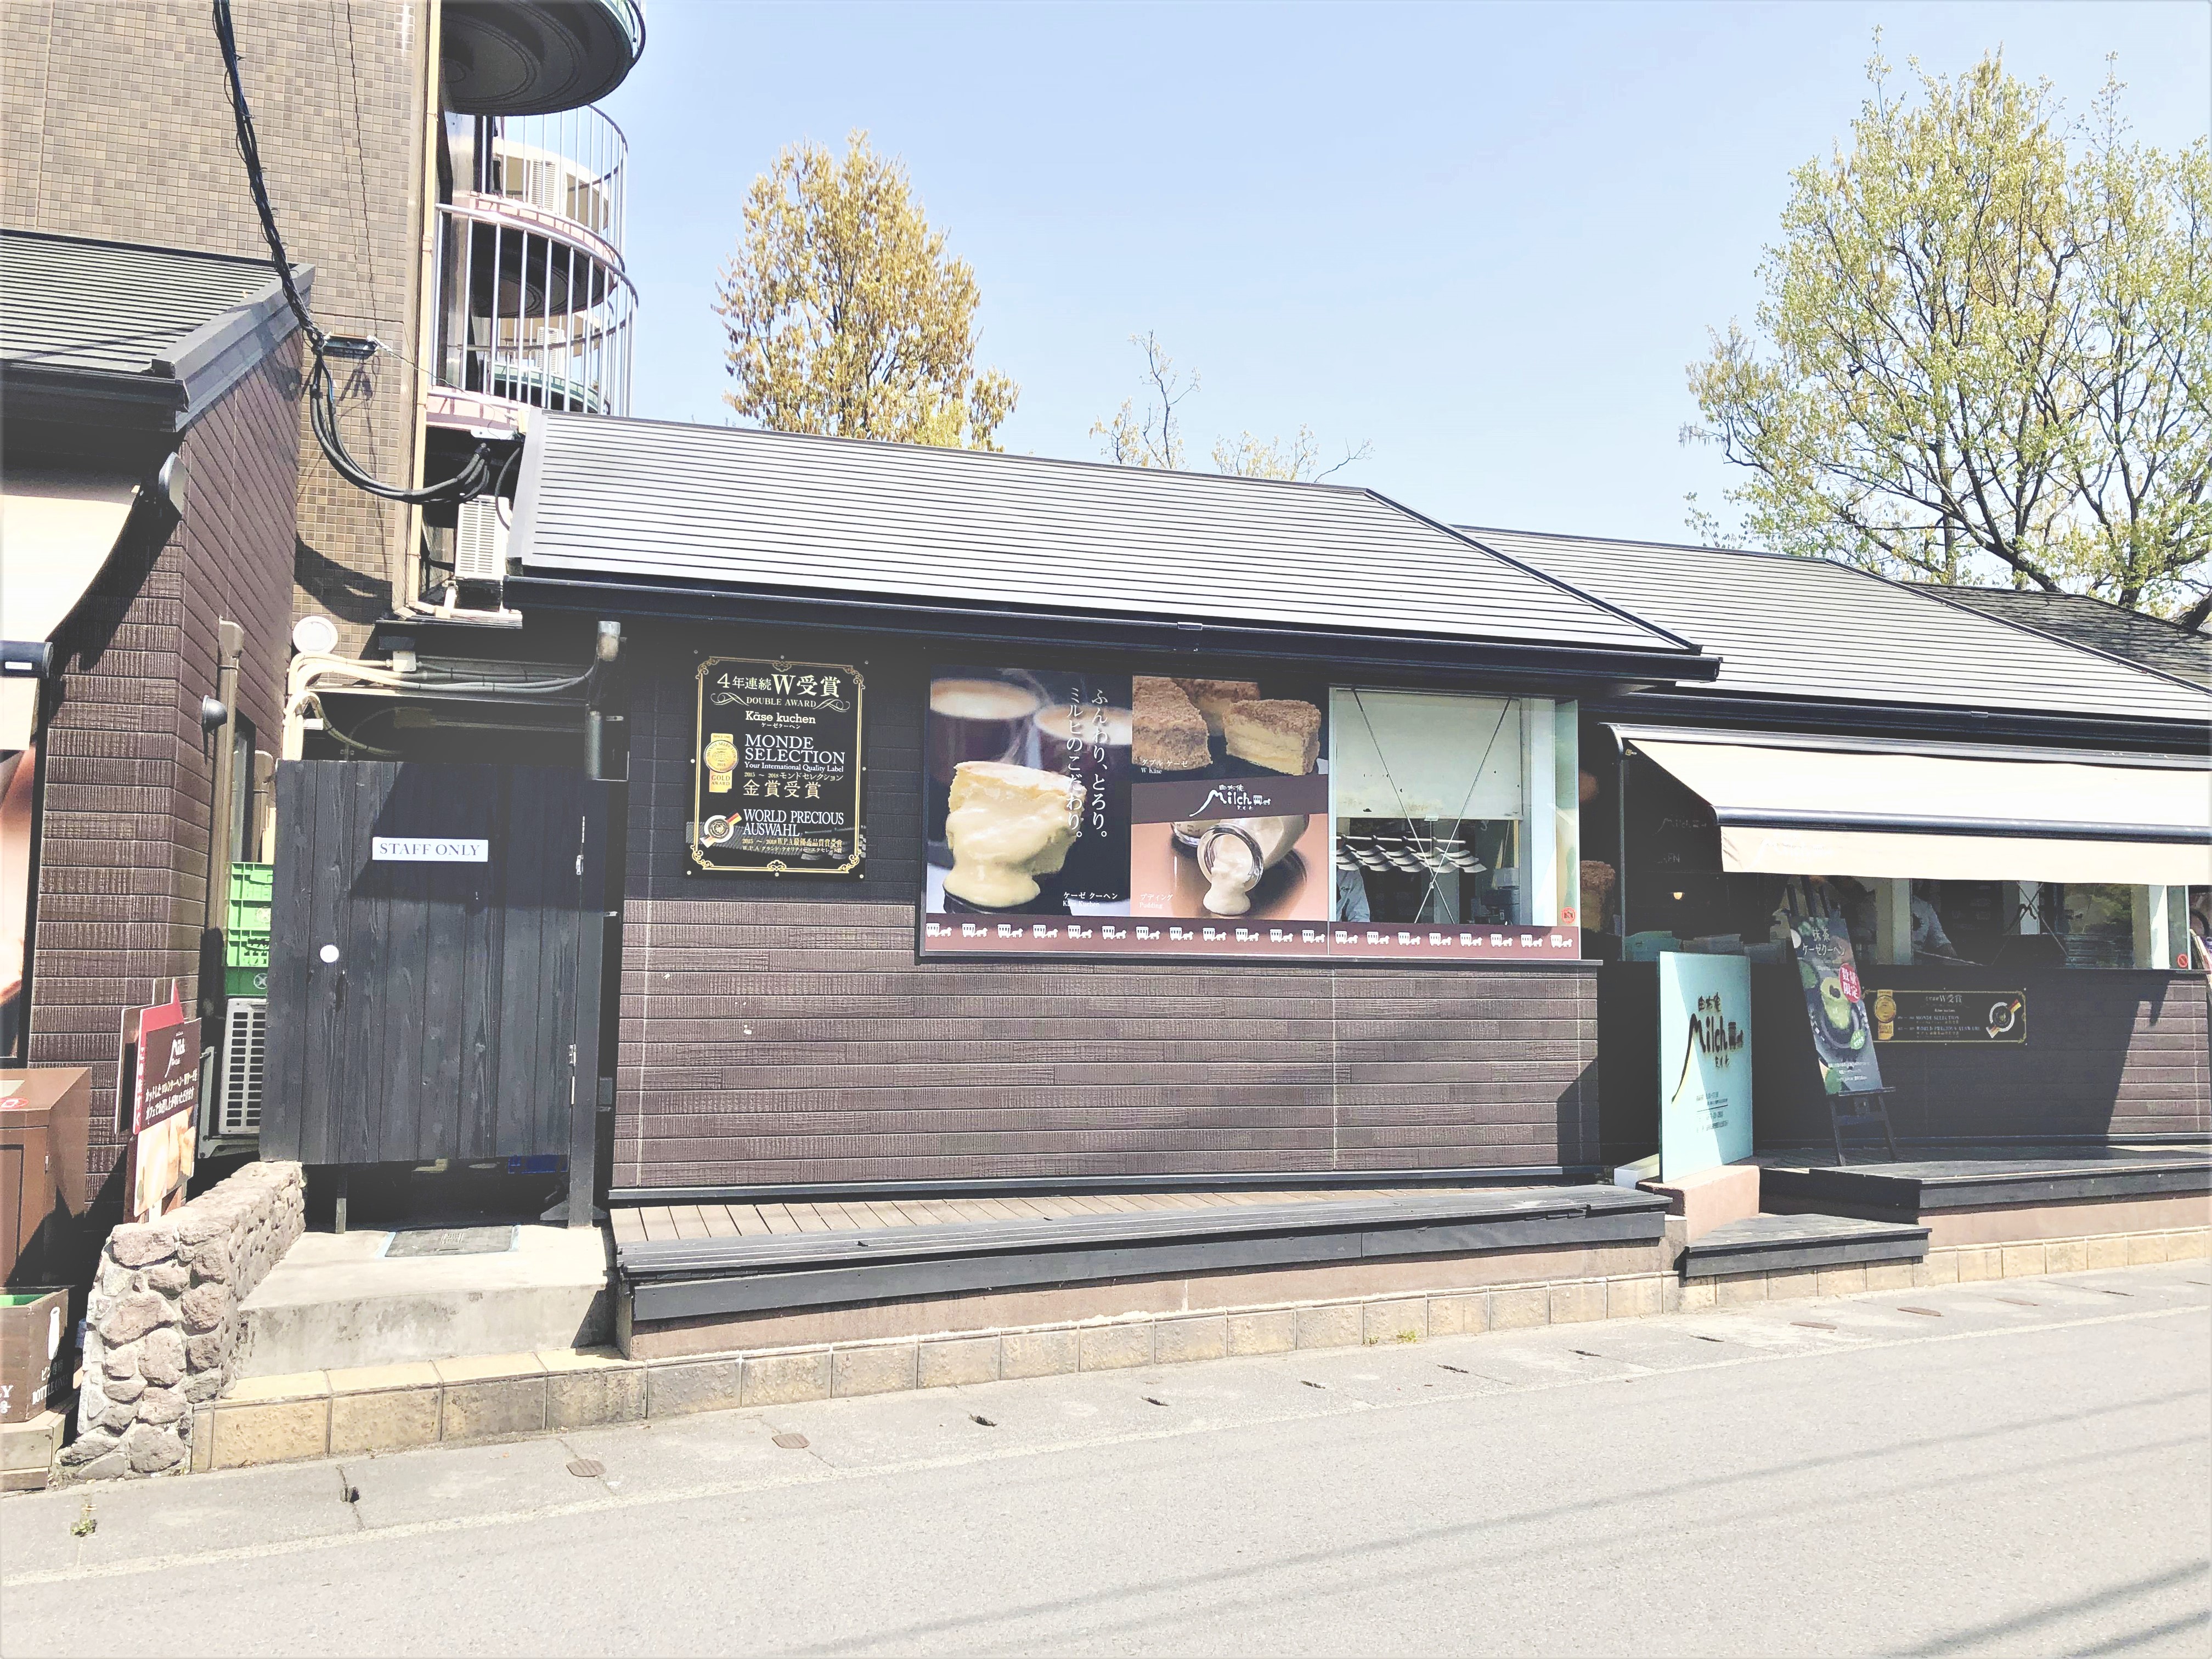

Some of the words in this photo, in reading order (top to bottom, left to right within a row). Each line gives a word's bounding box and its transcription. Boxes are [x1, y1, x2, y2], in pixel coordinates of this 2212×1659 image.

[717, 673, 840, 698] 4年連続W受賞
[746, 697, 782, 706] DOUBLE
[785, 698, 816, 708] AWARD
[745, 710, 774, 722] Käse
[776, 712, 816, 724] kuchen
[744, 733, 814, 749] MONDE
[745, 747, 845, 765] SELECTION
[1066, 687, 1083, 838] ミルヒのこだわり。
[1092, 689, 1108, 837] ふんわり、とろり。
[761, 762, 801, 771] International
[803, 764, 825, 774] Quality
[743, 778, 821, 799] 金賞受賞
[1189, 789, 1252, 817] Milch
[743, 809, 787, 823] WORLD
[790, 810, 844, 825] PRECIOUS
[742, 822, 800, 837] AUSWAHL
[380, 843, 431, 855] STAFF
[435, 844, 480, 856] ONLY
[1671, 1013, 1728, 1104] Milch
